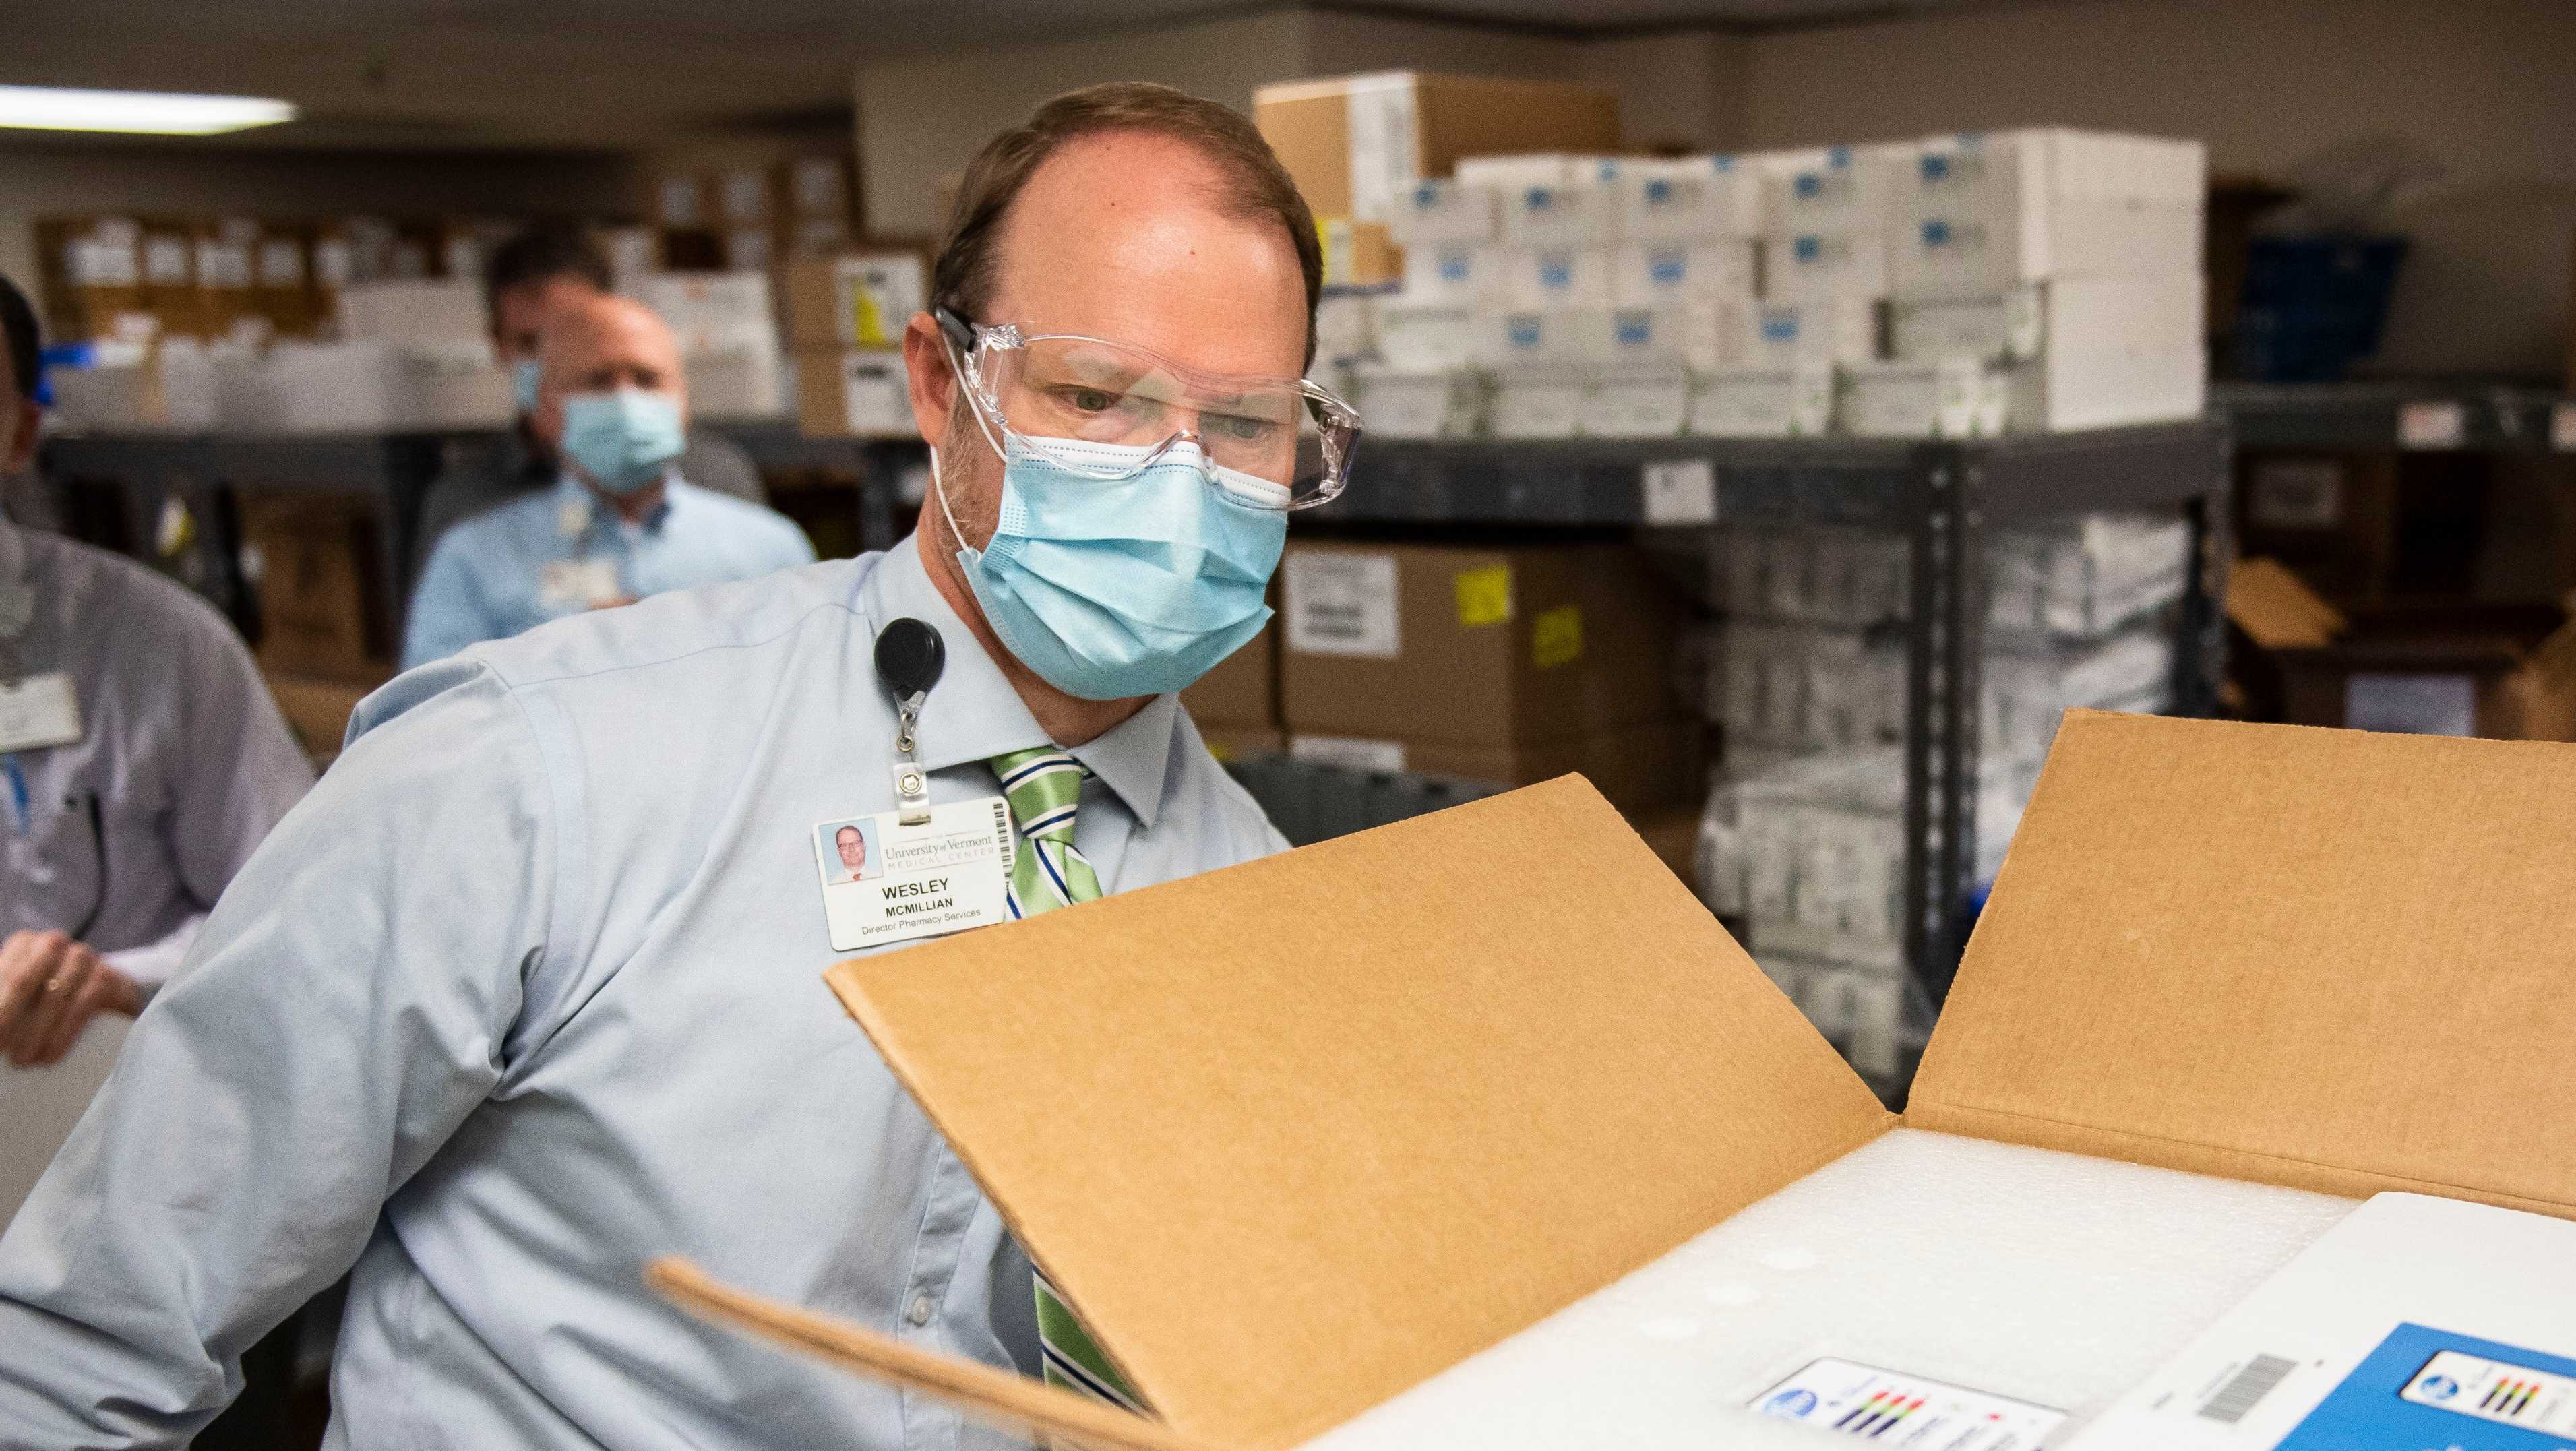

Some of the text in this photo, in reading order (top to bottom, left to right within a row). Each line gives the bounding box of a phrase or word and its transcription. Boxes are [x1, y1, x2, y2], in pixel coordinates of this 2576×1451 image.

[886, 844, 939, 859] University
[947, 836, 992, 849] Vermont
[888, 848, 994, 870] MEDICAL CENTER
[882, 877, 948, 900] WESLEY
[886, 898, 953, 917] MCMILLIAN
[862, 909, 981, 935] Director Pharmacy Services
